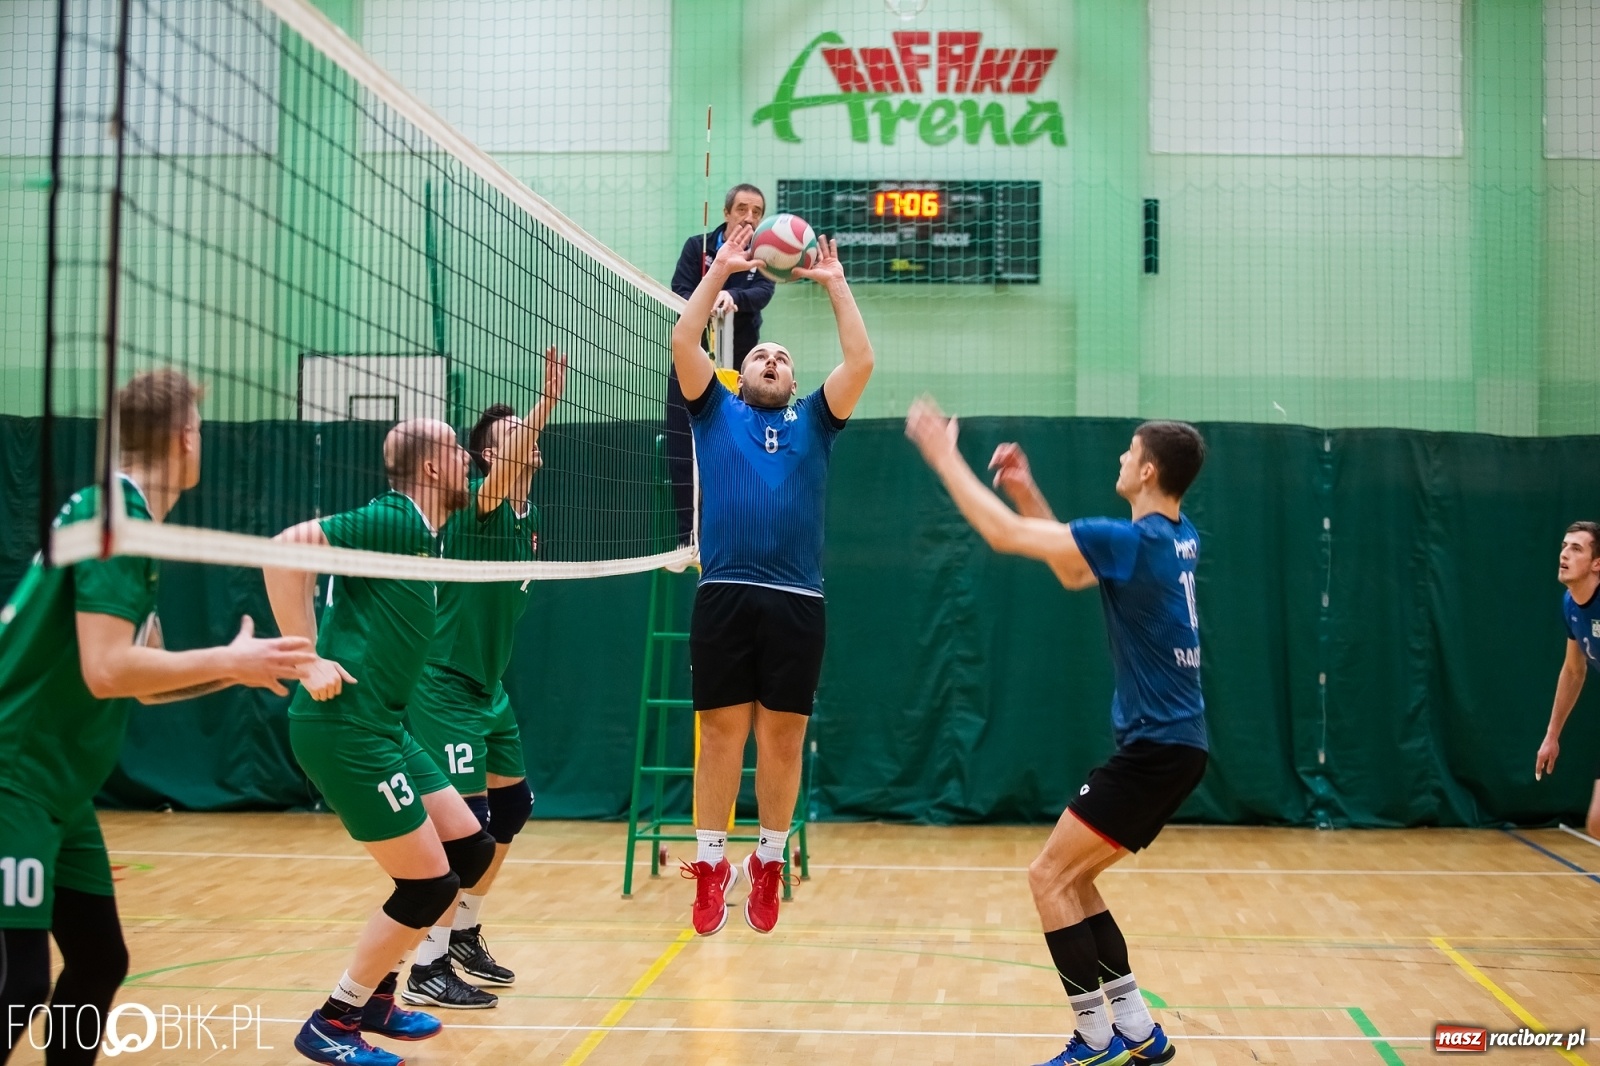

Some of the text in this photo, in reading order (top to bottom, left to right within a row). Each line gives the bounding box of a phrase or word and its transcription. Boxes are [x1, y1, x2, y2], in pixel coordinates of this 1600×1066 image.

[752, 31, 1067, 146] Arena
[765, 426, 778, 453] 8
[444, 743, 475, 774] 12
[378, 772, 415, 813] 13
[0, 856, 44, 907] 10
